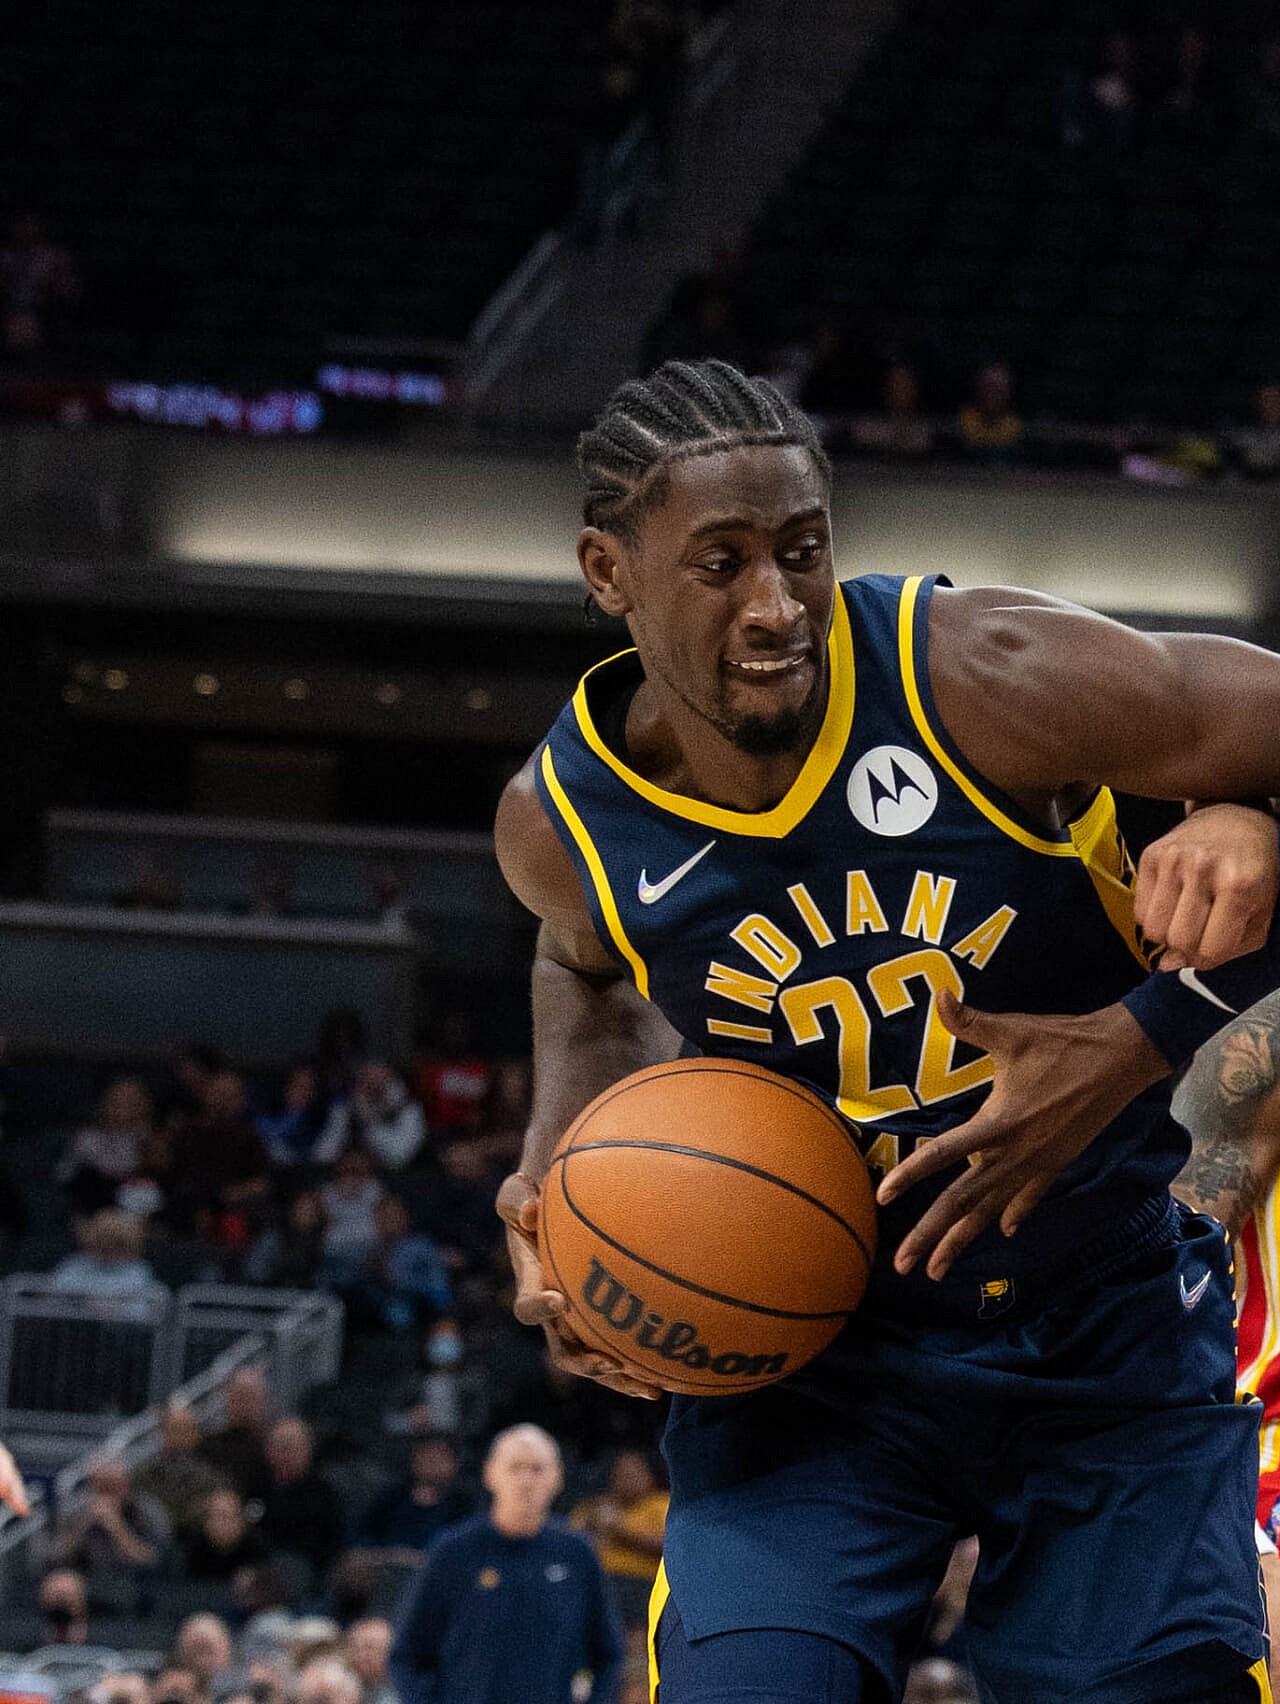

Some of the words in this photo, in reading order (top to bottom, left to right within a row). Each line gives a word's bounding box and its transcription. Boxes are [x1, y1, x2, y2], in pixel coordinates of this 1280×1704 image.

[705, 869, 1018, 1043] INDIANA
[778, 949, 994, 1122] 22
[582, 1255, 790, 1376] Wilson
